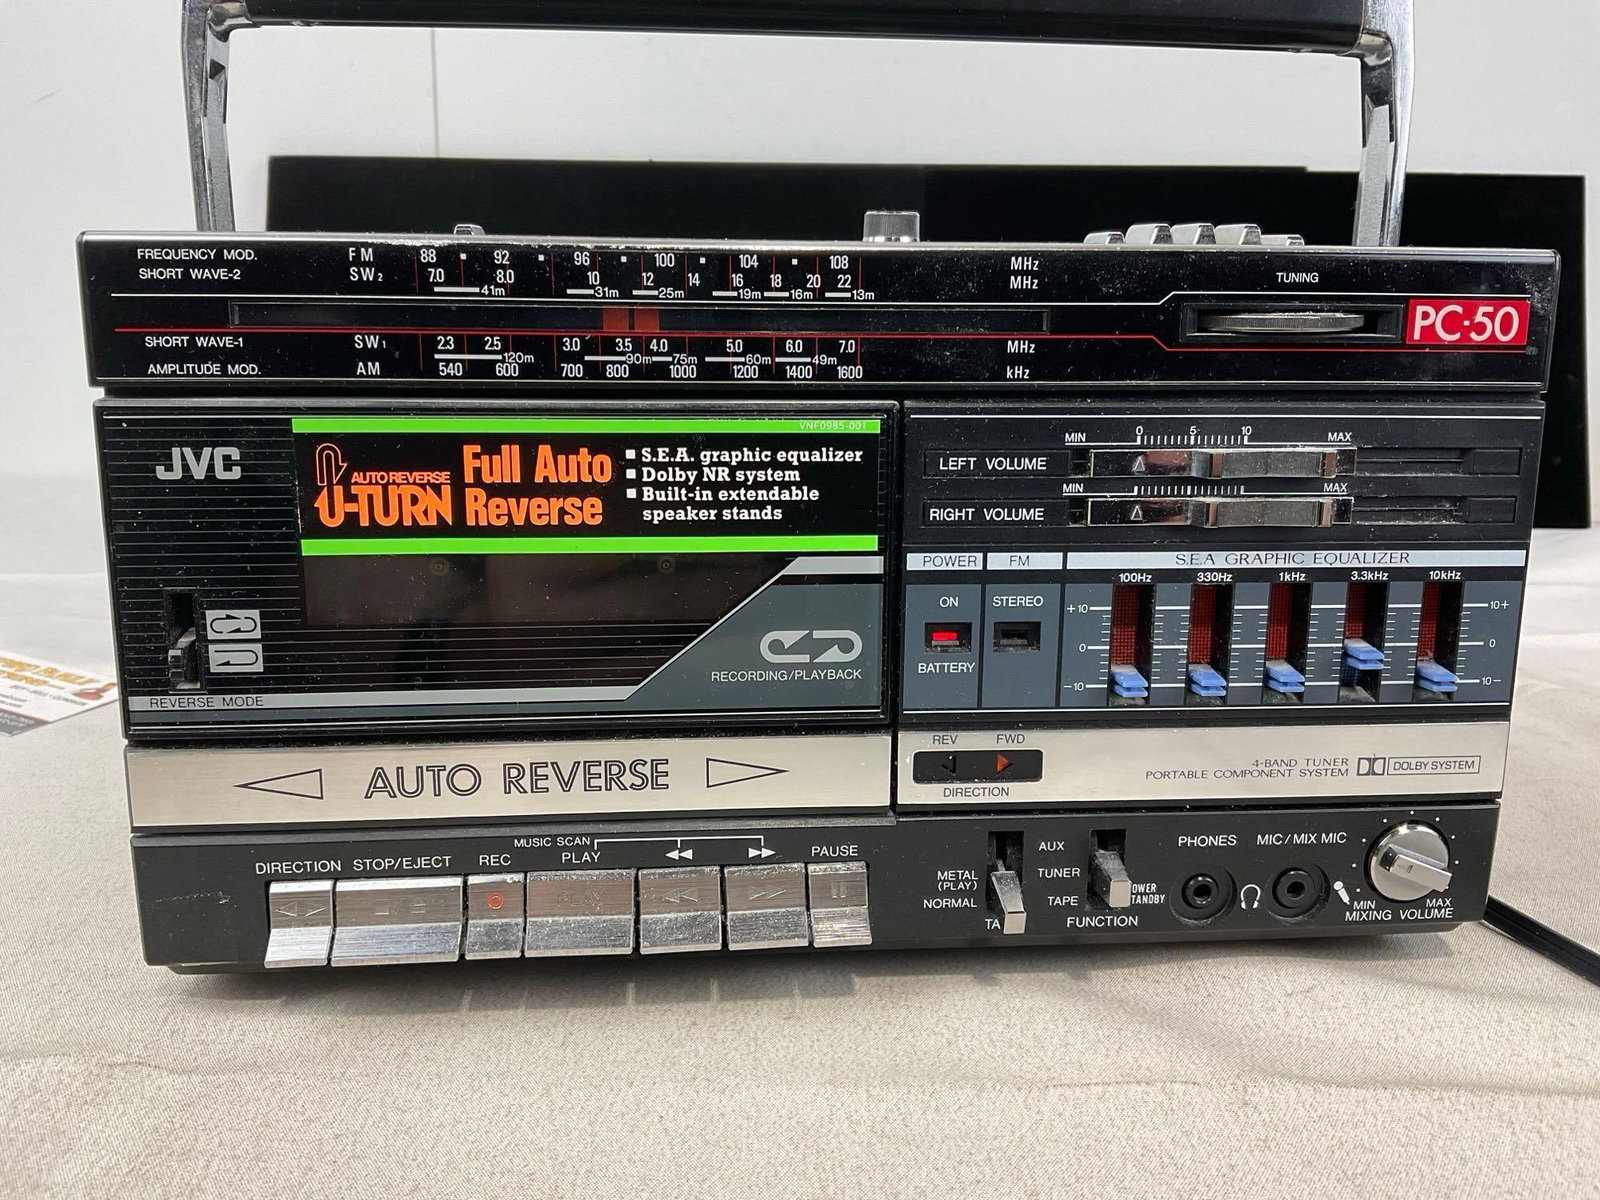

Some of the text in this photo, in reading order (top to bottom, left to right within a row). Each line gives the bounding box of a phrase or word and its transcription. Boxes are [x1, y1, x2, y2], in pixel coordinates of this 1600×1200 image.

[137, 249, 258, 260] FREQUENCY MOD.
[349, 247, 373, 262] FM
[420, 249, 848, 269] 88 92 96 100 104 108
[1010, 257, 1039, 270] MHz
[139, 268, 241, 280] SHORT WAVE-2
[428, 269, 852, 288] 7.0 8.0 10 12 14 16 18 20 22
[1276, 272, 1319, 283] TUNING
[1010, 276, 1039, 289] MHz
[481, 286, 875, 300] 41m 31m 25m 19m 16m 13m
[145, 337, 243, 347] SHORT WAVE-1
[437, 336, 855, 353] 2.3 2.5 3.0 3.5 4.0 5.0 6.0 7.0
[1007, 340, 1036, 353] MHz
[503, 353, 837, 365] 120m 90m 75m 60m 49m
[148, 364, 261, 375] AMPLITUDE MOD.
[357, 362, 380, 375] AM
[439, 363, 863, 379] 540 600 700 800 1000 1200 1400 1600
[1006, 366, 1030, 379] kHz
[799, 421, 866, 430] VNF0985-001
[1136, 426, 1252, 435] 0 5 10
[1065, 433, 1086, 442] MIN
[1328, 432, 1352, 441] MAX
[641, 448, 863, 464] S.E.A. graphic equalizer
[156, 447, 241, 480] JVC
[463, 445, 612, 484] Full Auto
[939, 457, 1047, 470] LEFT VOLUME
[351, 471, 451, 484] AUTO REVERSE
[641, 467, 801, 485] Dolby NR system
[642, 486, 820, 501] Built-in extendable
[1063, 484, 1083, 493] MIN
[1324, 483, 1348, 492] MAX
[313, 485, 453, 528] U-TURN
[465, 488, 603, 526] Reverse
[643, 506, 782, 524] speaker stands
[929, 508, 1044, 521] RIGHT VOLUME
[923, 556, 977, 567] POWER
[1009, 555, 1030, 567] FM
[1225, 553, 1305, 565] GRAPHIC
[1313, 552, 1410, 565] EQUALIZER
[1119, 572, 1152, 583] 100Hz
[1197, 571, 1233, 582] 330Hz
[1278, 571, 1306, 581] 1kHz
[1351, 571, 1389, 581] 3.3kHz
[1429, 570, 1461, 580] 10kHz
[939, 597, 959, 607] ON
[992, 596, 1044, 607] STEREO
[1067, 604, 1088, 613] +10
[1079, 643, 1086, 652] 0
[1489, 639, 1496, 648] 0
[918, 662, 975, 674] BATTERY
[711, 669, 862, 682] RECORDING/PLAYBACK
[150, 696, 264, 709] REVERSE MODE
[932, 735, 958, 745] REV
[996, 734, 1025, 744] FWD
[1251, 757, 1349, 768] 4-BAND TUNER
[1393, 760, 1475, 772] DOLBY SYSTEM
[364, 758, 669, 799] AUTO REVERSE
[1145, 768, 1349, 780] PORTABLE COMPONENT SYSTEM
[943, 787, 1009, 798] DIRECTION
[514, 836, 590, 848] MUSIC SCAN
[1178, 834, 1237, 847] PHONES
[1321, 832, 1347, 844] MIC
[811, 845, 858, 857] PAUSE
[1039, 841, 1065, 851] AUX
[479, 854, 511, 866] REC
[562, 851, 601, 864] PLAY
[255, 860, 342, 875] DIRECTION
[353, 856, 451, 872] STOP/EJECT
[937, 870, 978, 881] METAL
[1038, 868, 1080, 878] TUNER
[937, 881, 978, 891] (PLAY)
[1131, 883, 1157, 893] OWER
[923, 898, 977, 909] NORMAL
[1048, 896, 1078, 906] TAPE
[1131, 894, 1166, 904] TANDBY
[1353, 900, 1376, 910] MIN
[1426, 898, 1452, 908] MAX
[1345, 907, 1454, 921] MIXING VOLUME
[1067, 915, 1138, 928] FUNCTION
